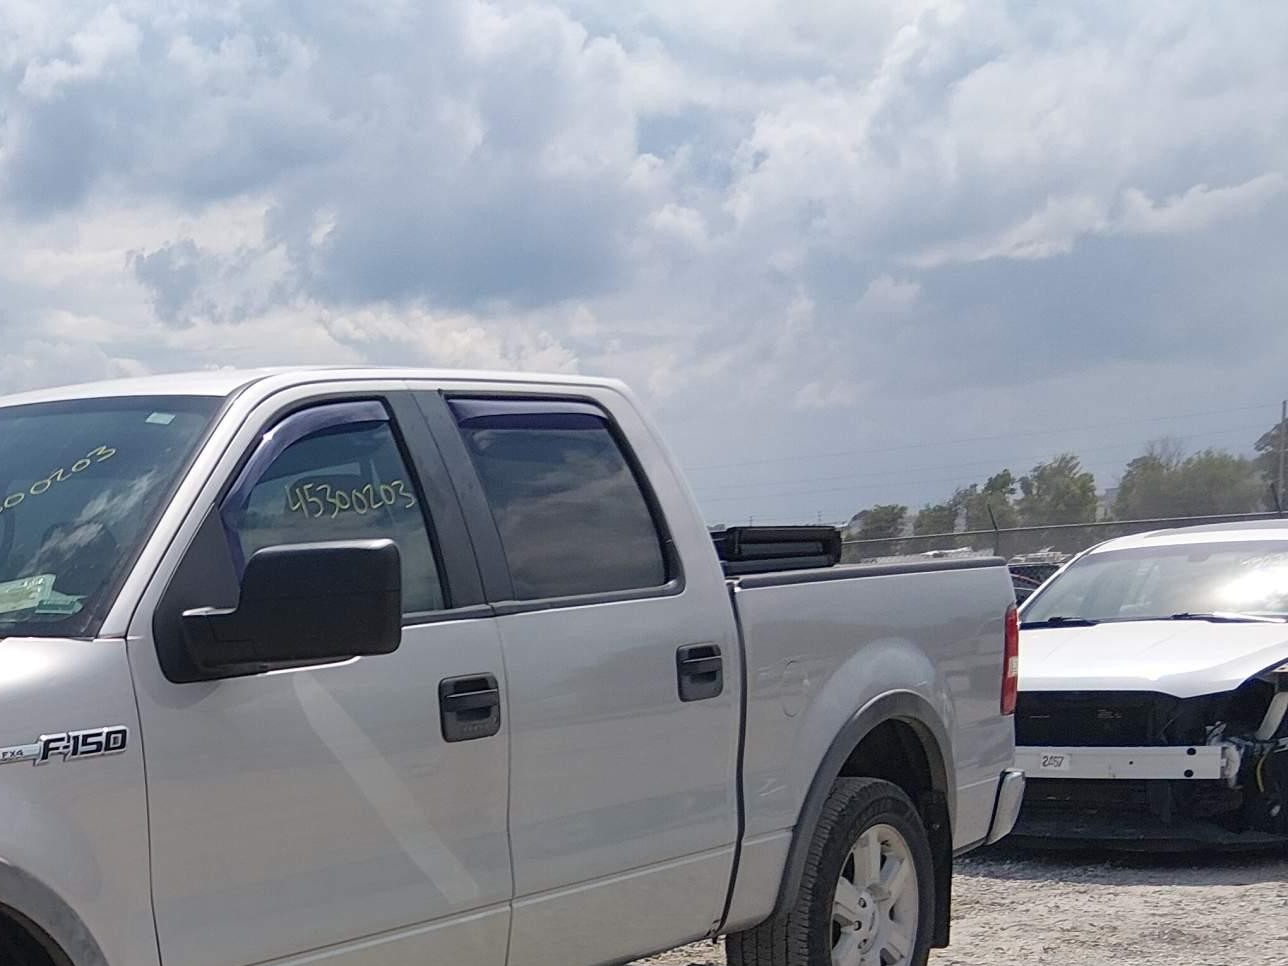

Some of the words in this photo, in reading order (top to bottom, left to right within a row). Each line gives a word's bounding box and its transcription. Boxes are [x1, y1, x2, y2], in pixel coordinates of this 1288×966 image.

[284, 480, 417, 519] 45300203
[1, 749, 24, 760] FX4
[40, 728, 128, 761] F-150
